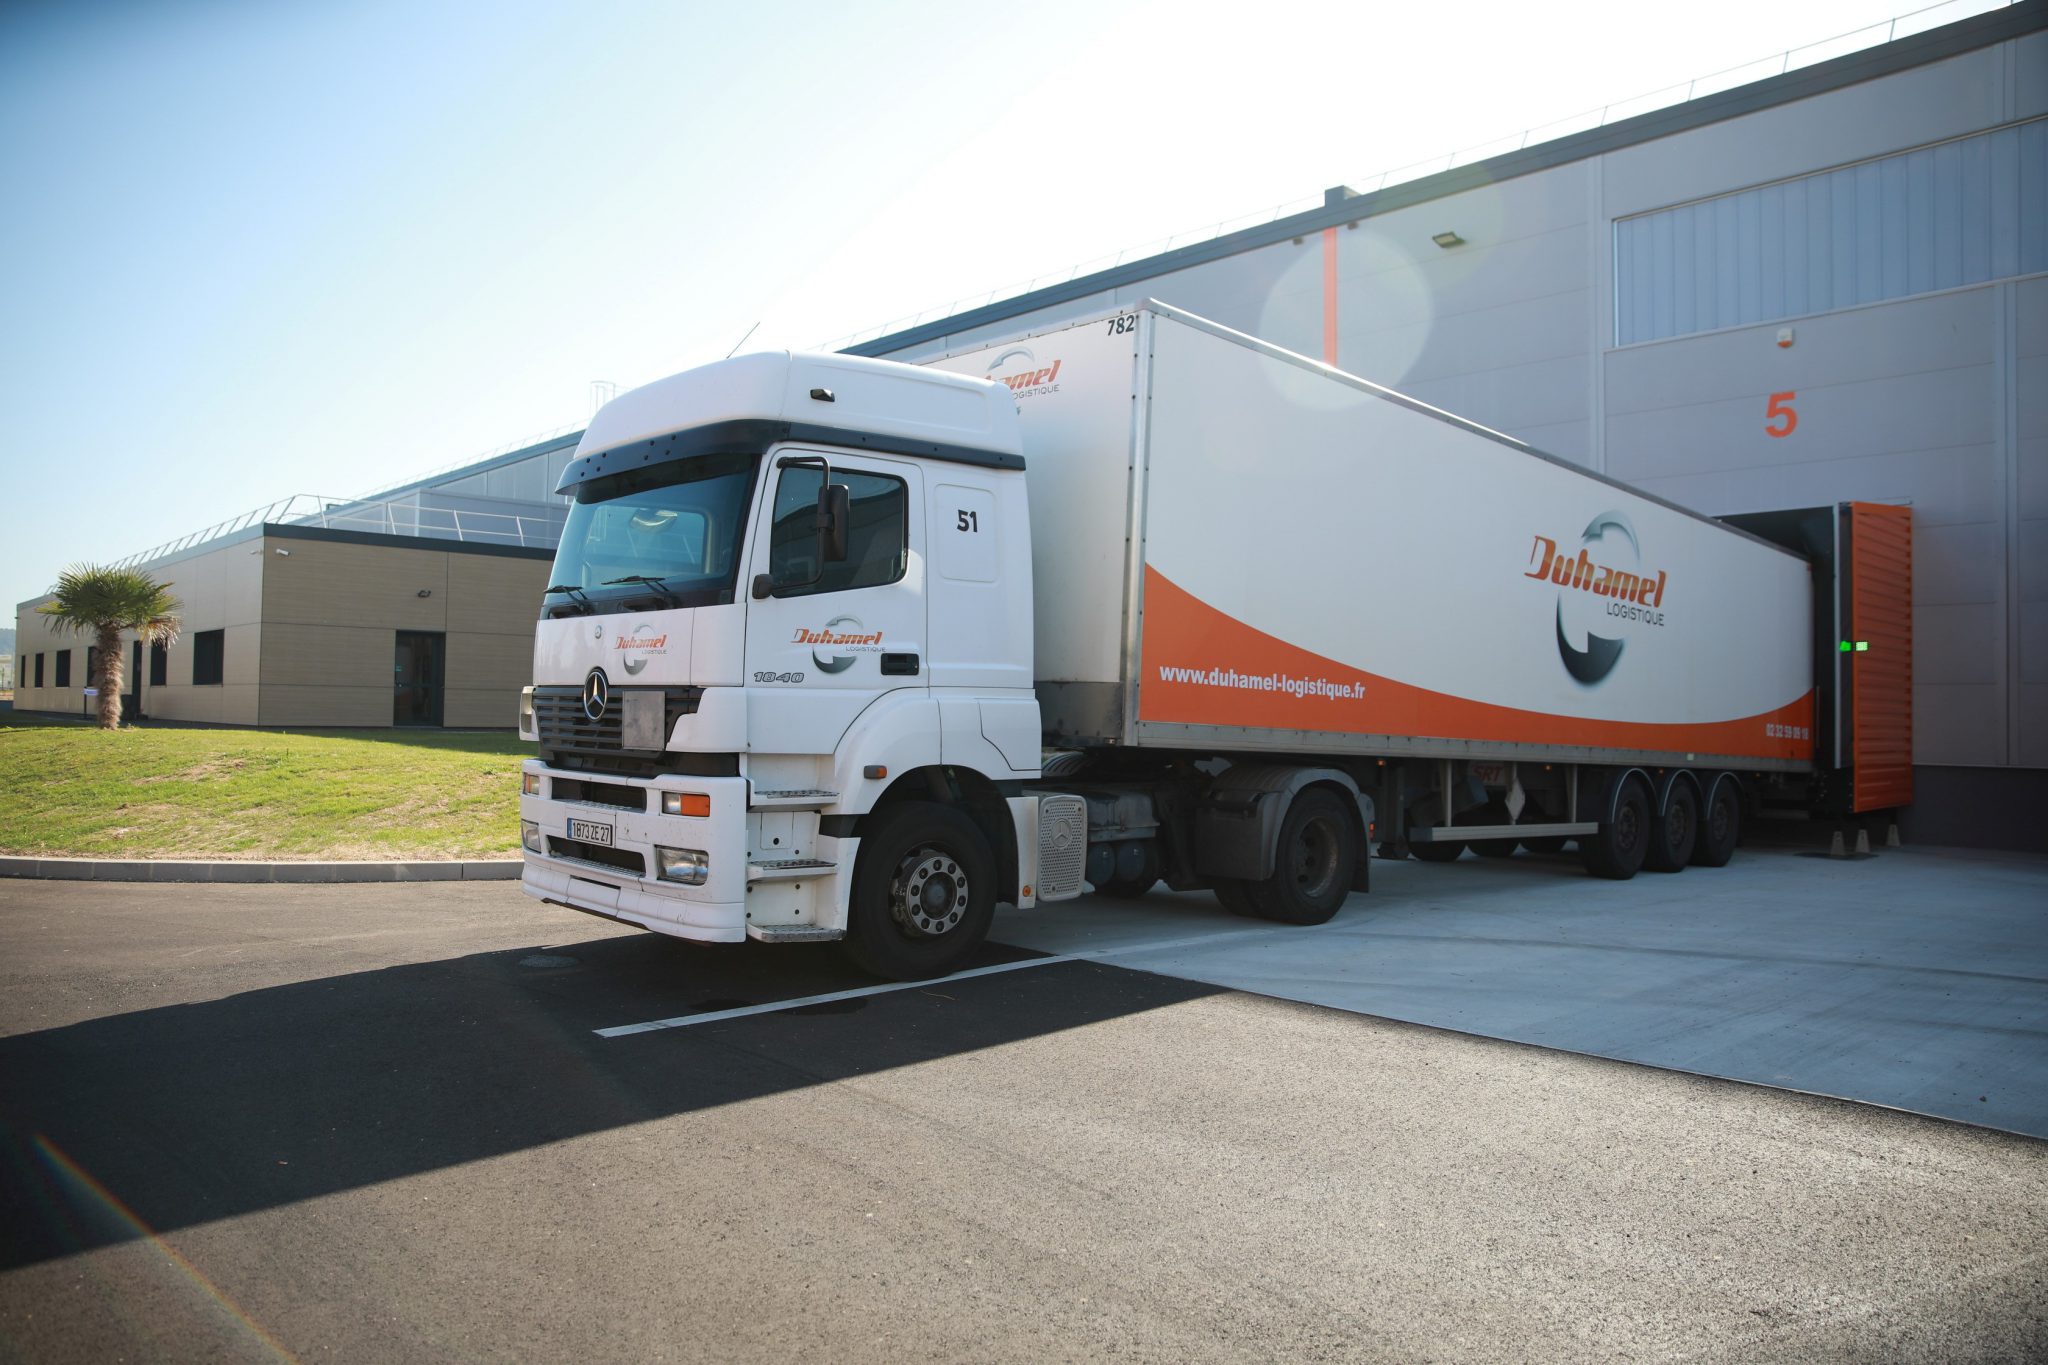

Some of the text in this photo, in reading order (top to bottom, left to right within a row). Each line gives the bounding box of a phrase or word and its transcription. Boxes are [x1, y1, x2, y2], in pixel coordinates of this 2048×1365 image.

[1107, 314, 1135, 336] 782
[983, 359, 1062, 391] amel
[1012, 384, 1060, 400] OGISTIQUE
[1765, 391, 1797, 438] 5
[956, 509, 978, 533] 51
[1524, 535, 1667, 608] Duhamel
[1606, 602, 1665, 627] LOGISTIQUE
[613, 634, 668, 650] Duhamel
[790, 628, 883, 646] Duhamel
[845, 645, 887, 653] LOGISTIQUE
[753, 671, 805, 683] 1840
[1159, 665, 1366, 701] www.duhamel-logistique.fr
[573, 822, 610, 842] 1873 ZE 27
